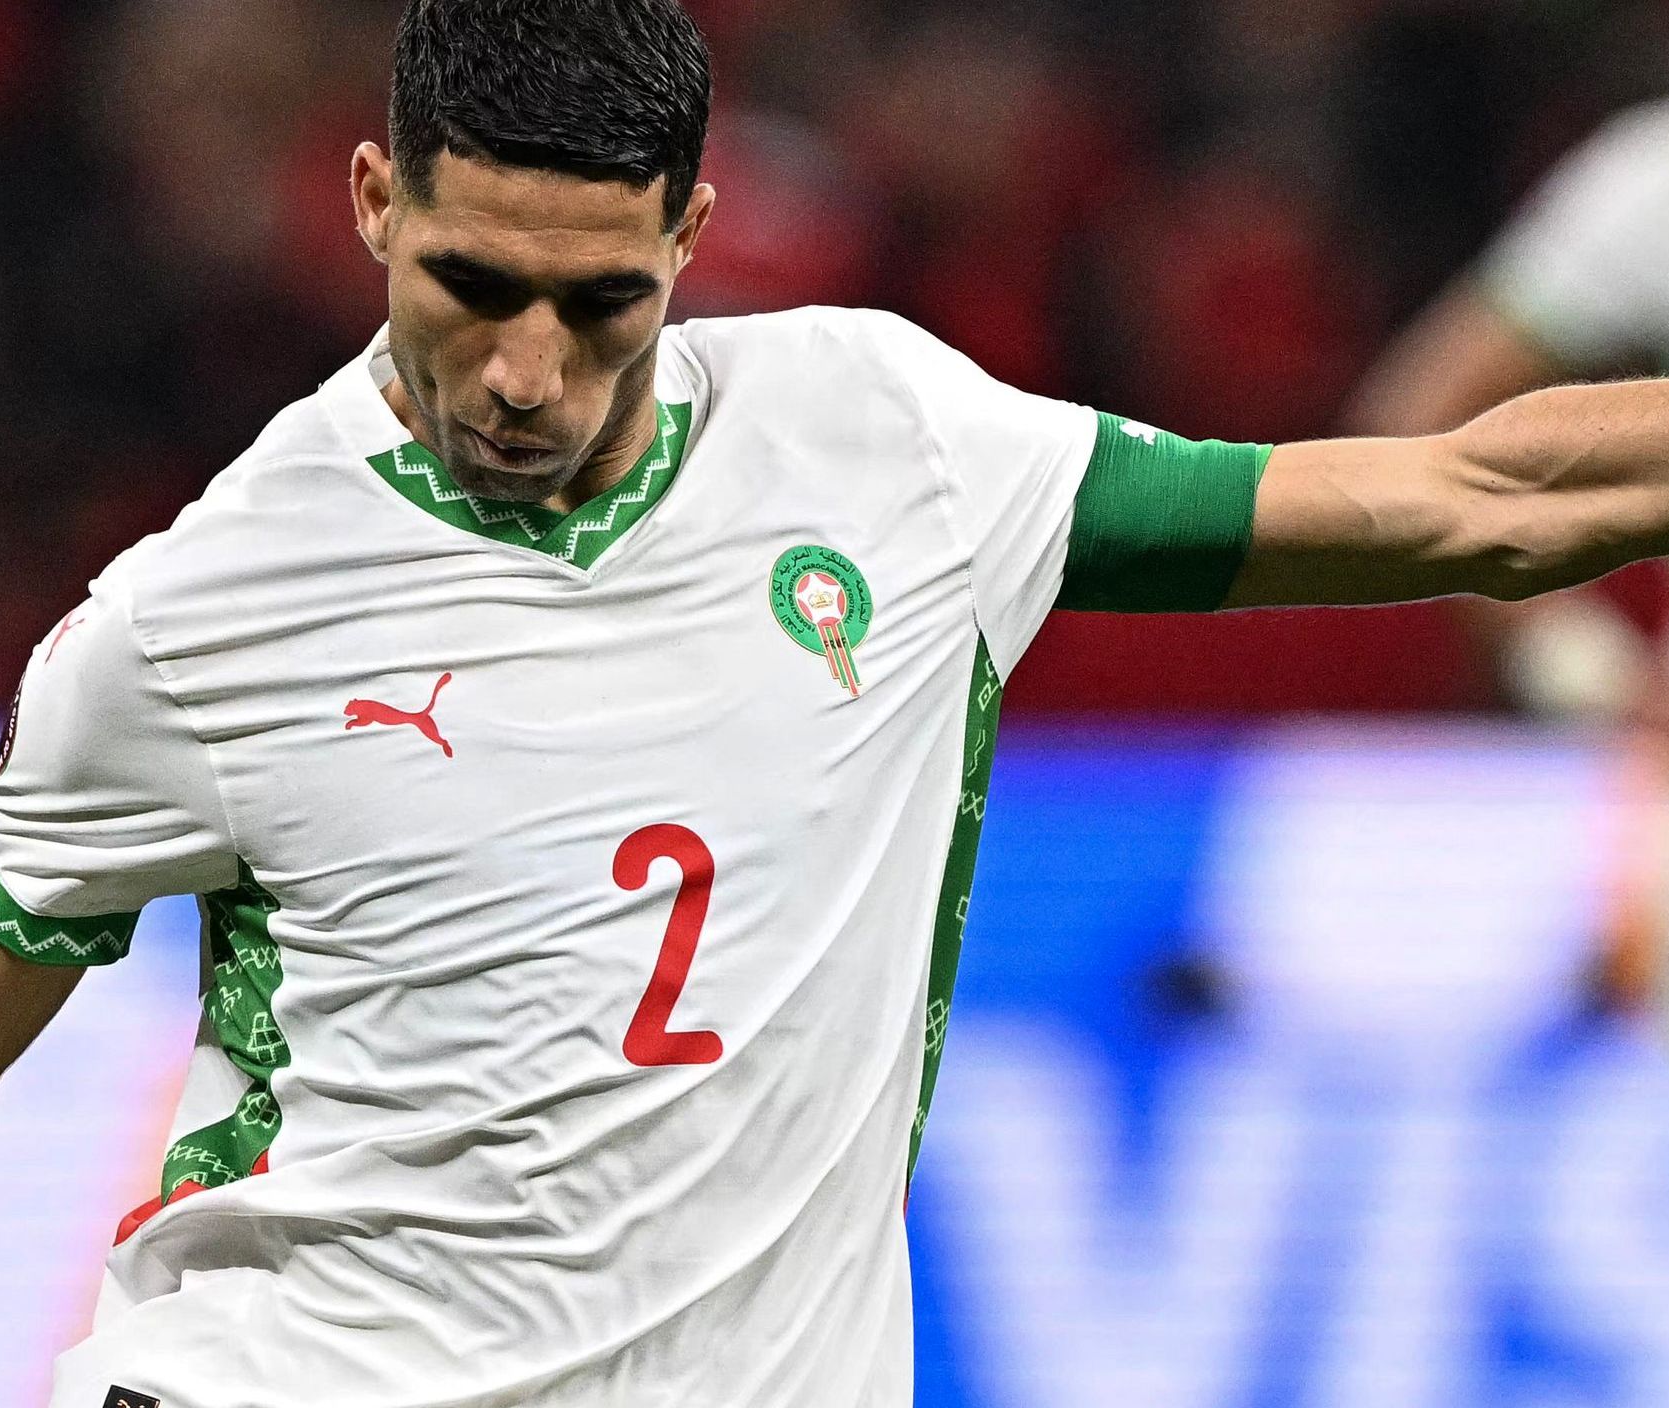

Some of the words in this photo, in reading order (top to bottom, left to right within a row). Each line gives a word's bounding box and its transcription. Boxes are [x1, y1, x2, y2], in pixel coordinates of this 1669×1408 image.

[801, 563, 840, 579] MAROCAINE
[818, 547, 855, 575] الملكية
[788, 568, 802, 593] ROYALE
[840, 577, 849, 587] DE
[844, 588, 855, 625] FOOTBALL
[613, 823, 723, 1066] 2
